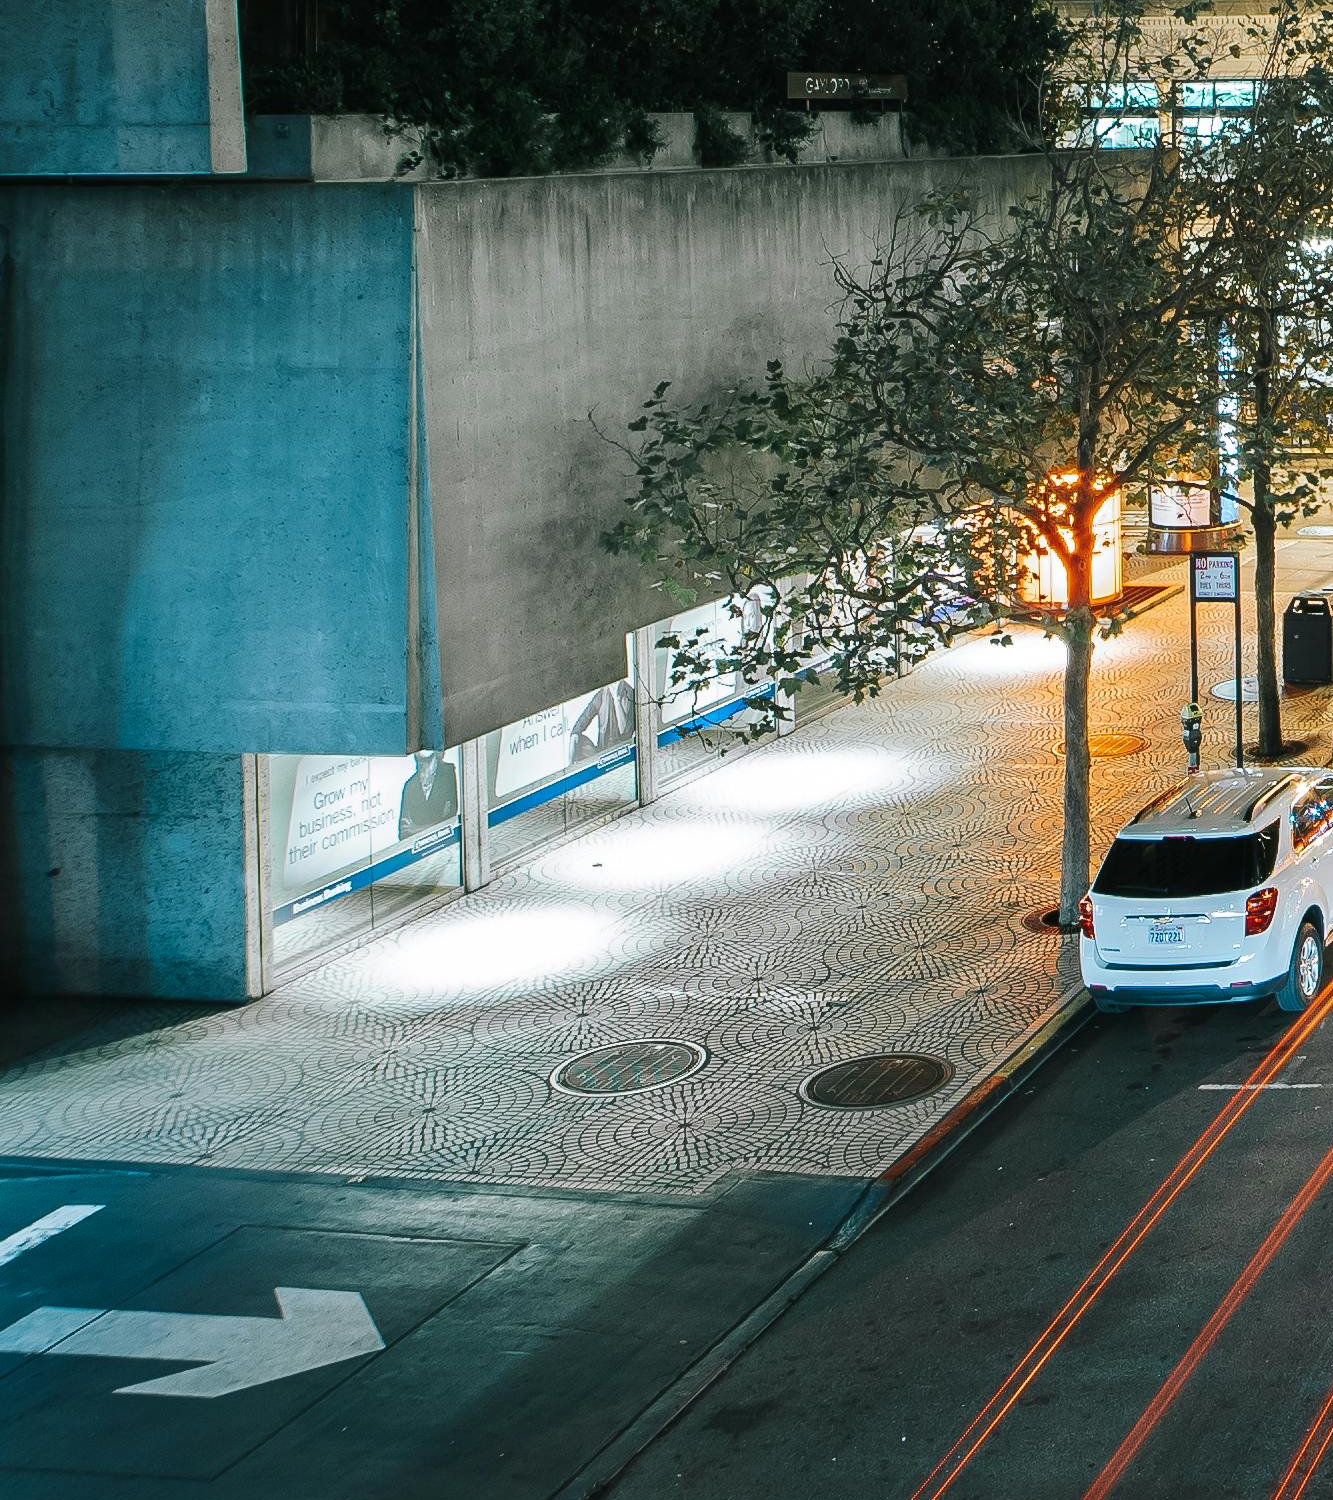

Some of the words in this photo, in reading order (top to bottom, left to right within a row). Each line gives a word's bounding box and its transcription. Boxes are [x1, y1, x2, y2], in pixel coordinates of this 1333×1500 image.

[1195, 557, 1207, 569] NO
[1208, 560, 1234, 569] PARKING
[509, 732, 539, 755] when
[313, 787, 347, 810] Grow
[350, 778, 369, 795] my
[361, 792, 382, 811] not
[288, 838, 318, 864] their
